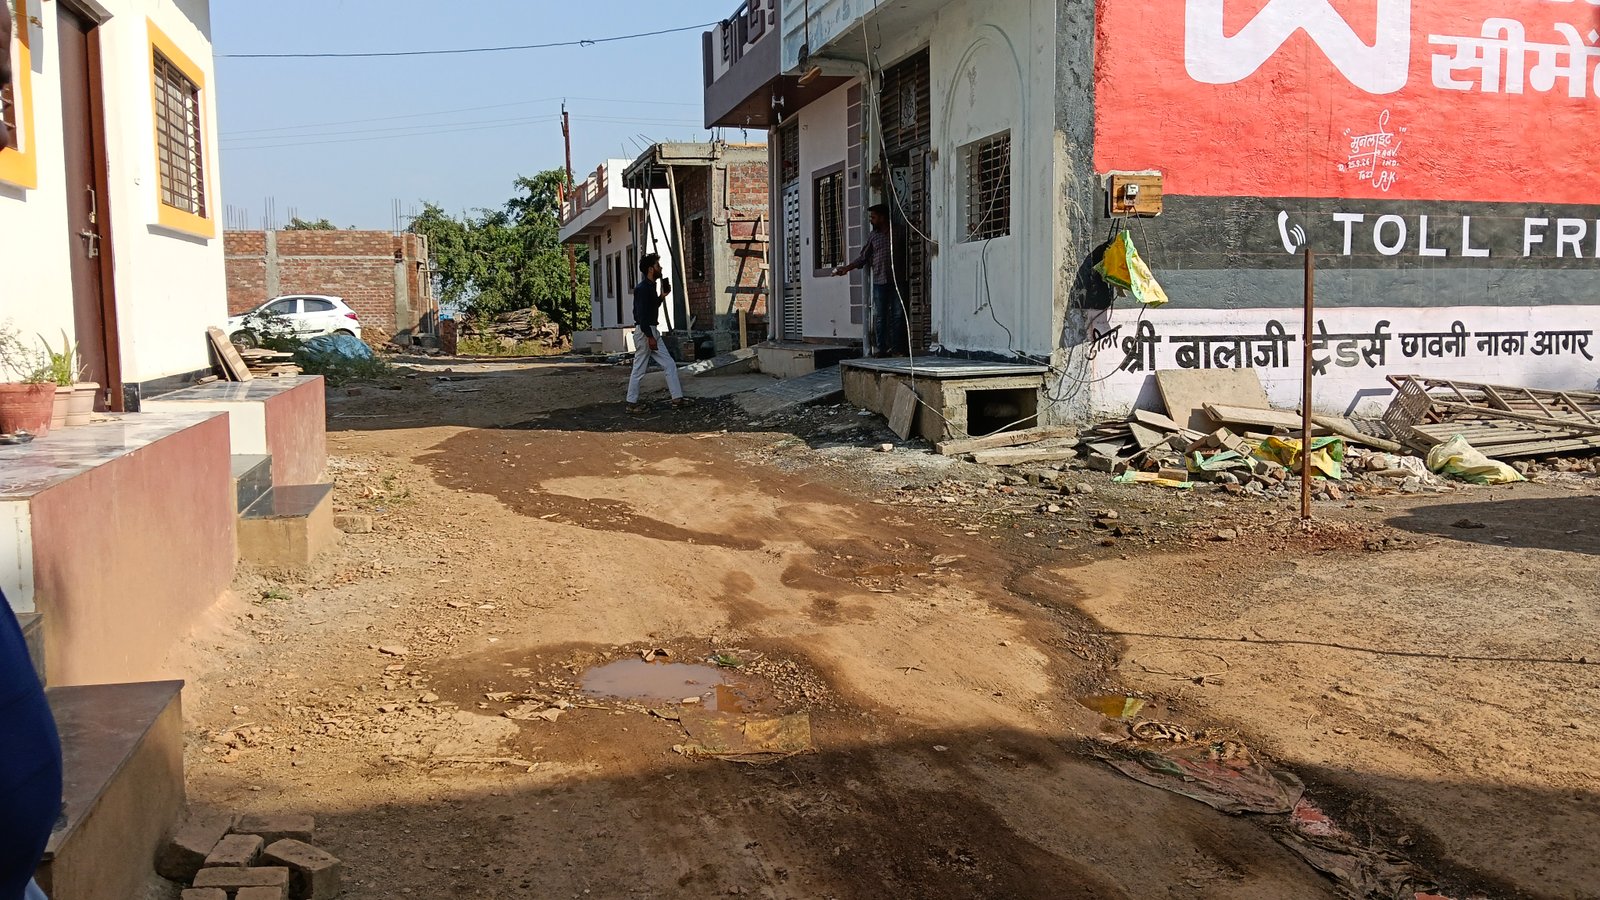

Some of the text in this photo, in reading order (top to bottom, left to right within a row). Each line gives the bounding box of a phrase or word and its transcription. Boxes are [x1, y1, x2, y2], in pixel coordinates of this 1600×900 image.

[1428, 17, 1600, 98] सीमें
[1333, 212, 1600, 258] TOLL FR
[1118, 319, 1594, 376] श्री बालाजी ट्रेडर्स छावनी नाका आगर
